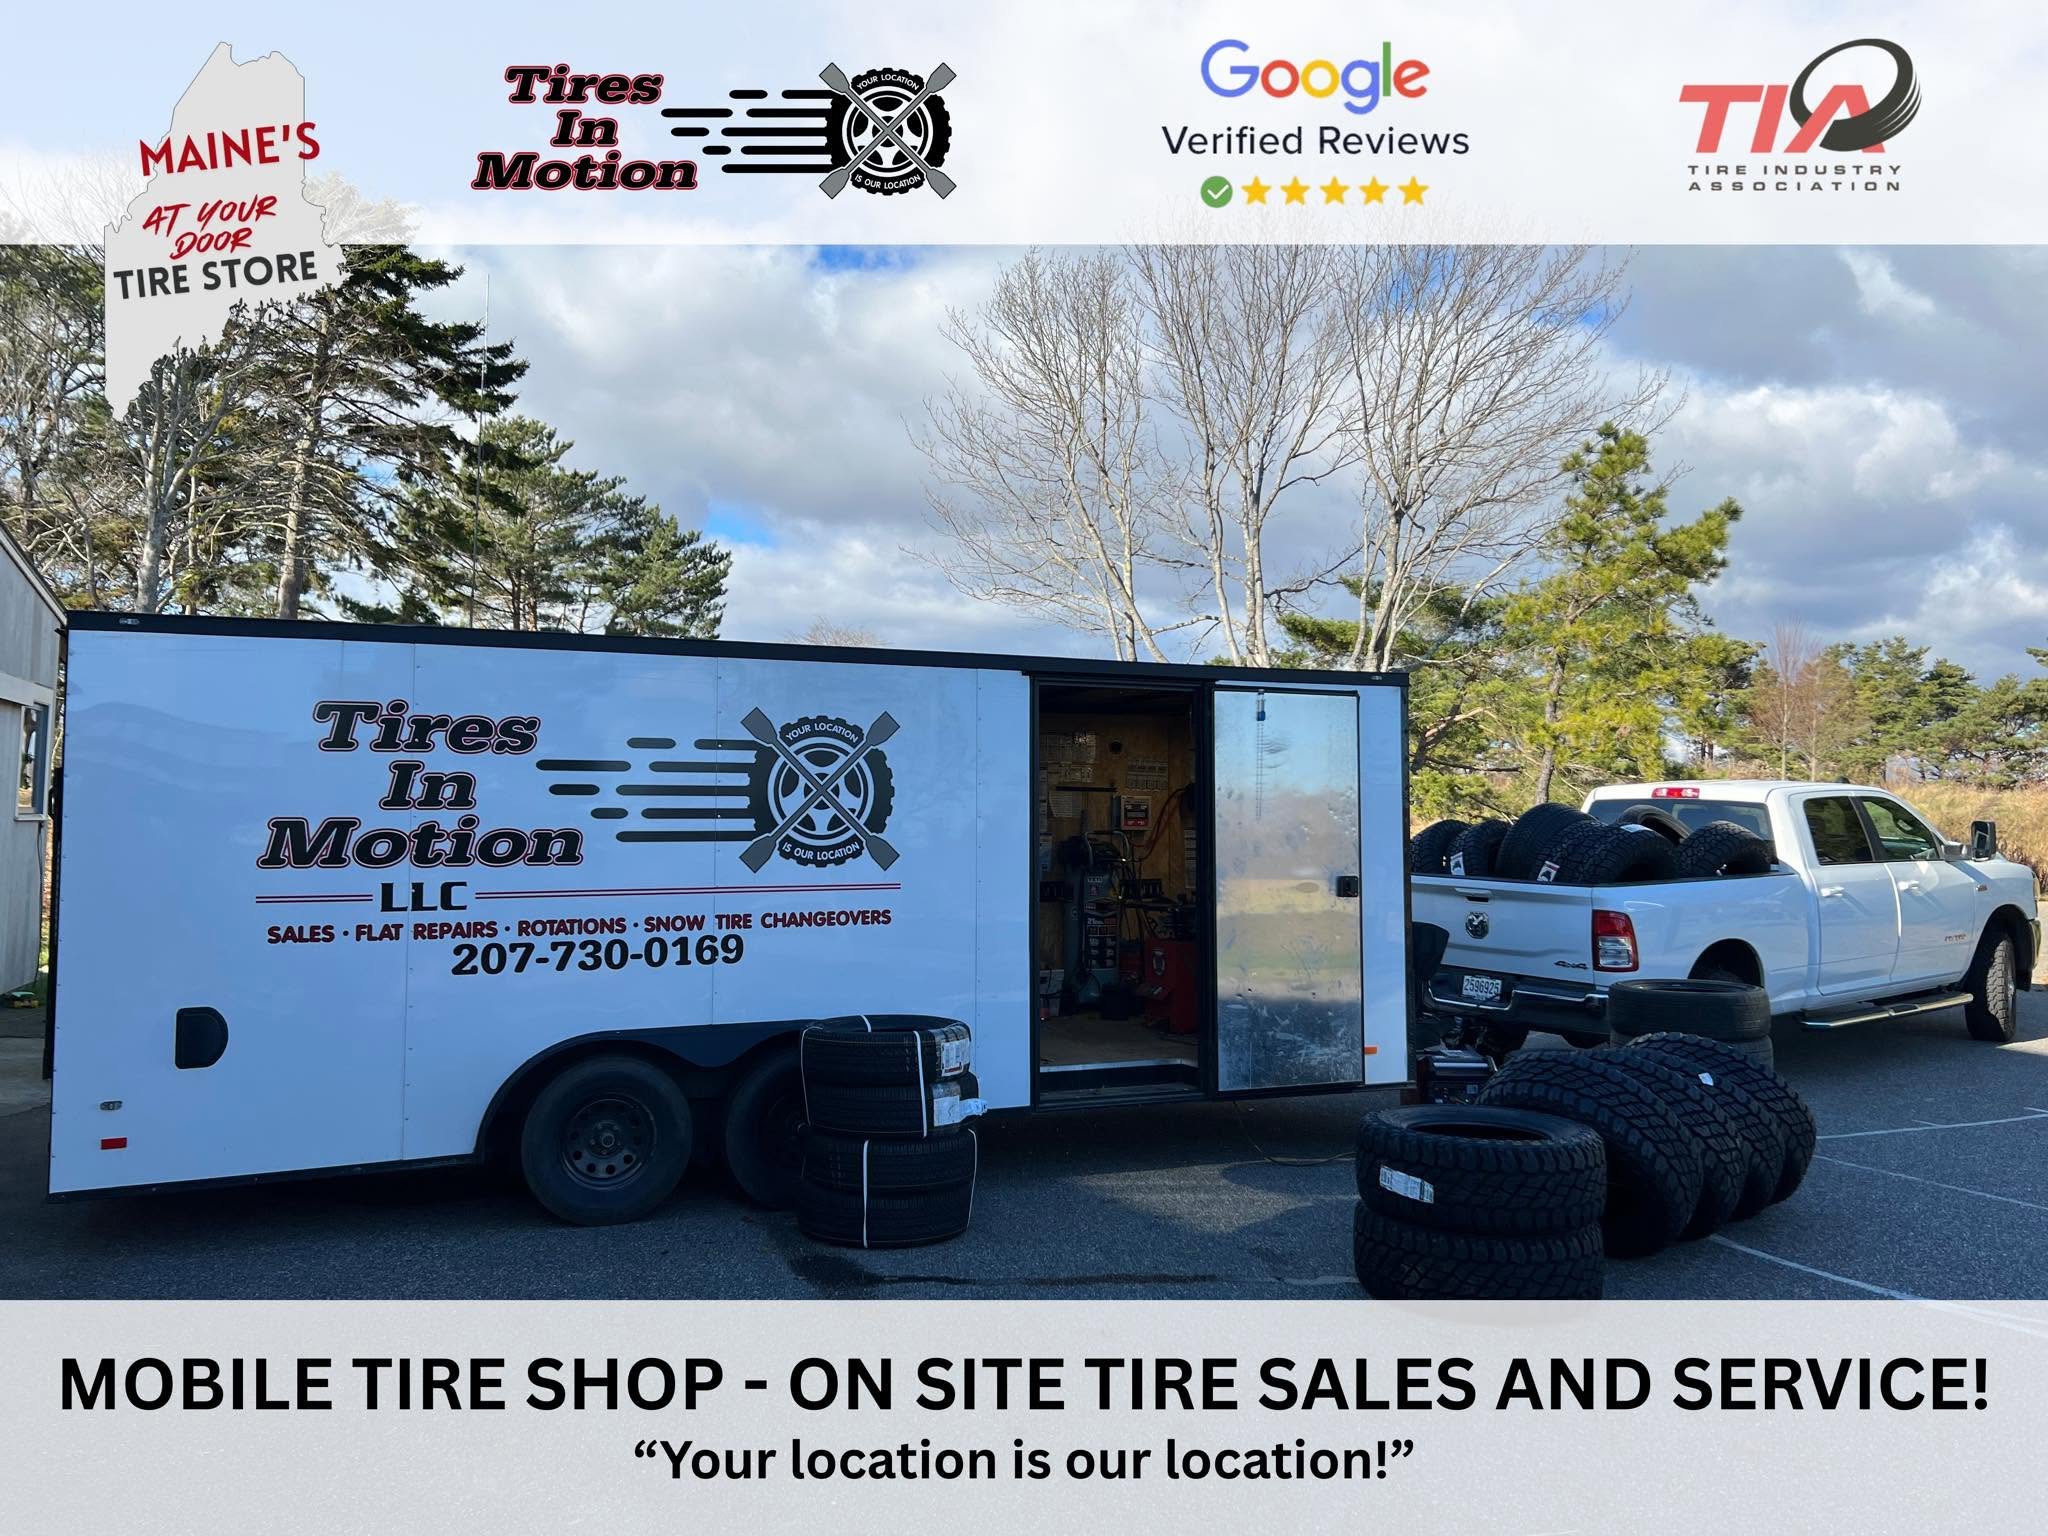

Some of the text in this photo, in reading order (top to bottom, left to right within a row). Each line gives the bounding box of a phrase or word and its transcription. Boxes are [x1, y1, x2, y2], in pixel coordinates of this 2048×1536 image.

[313, 699, 541, 755] Tires
[786, 722, 859, 743] YOUR LOCATION
[378, 759, 478, 810] In
[256, 814, 584, 870] Motion
[782, 841, 860, 861] IS OUR LOCATION
[380, 881, 469, 913] LLC
[267, 909, 892, 944] SALES FLAT REPAIRS ROTATIONS SNOW TIRE CHANGEOVERS
[451, 934, 745, 976] 207-730-0169
[1463, 977, 1501, 995] 2596925
